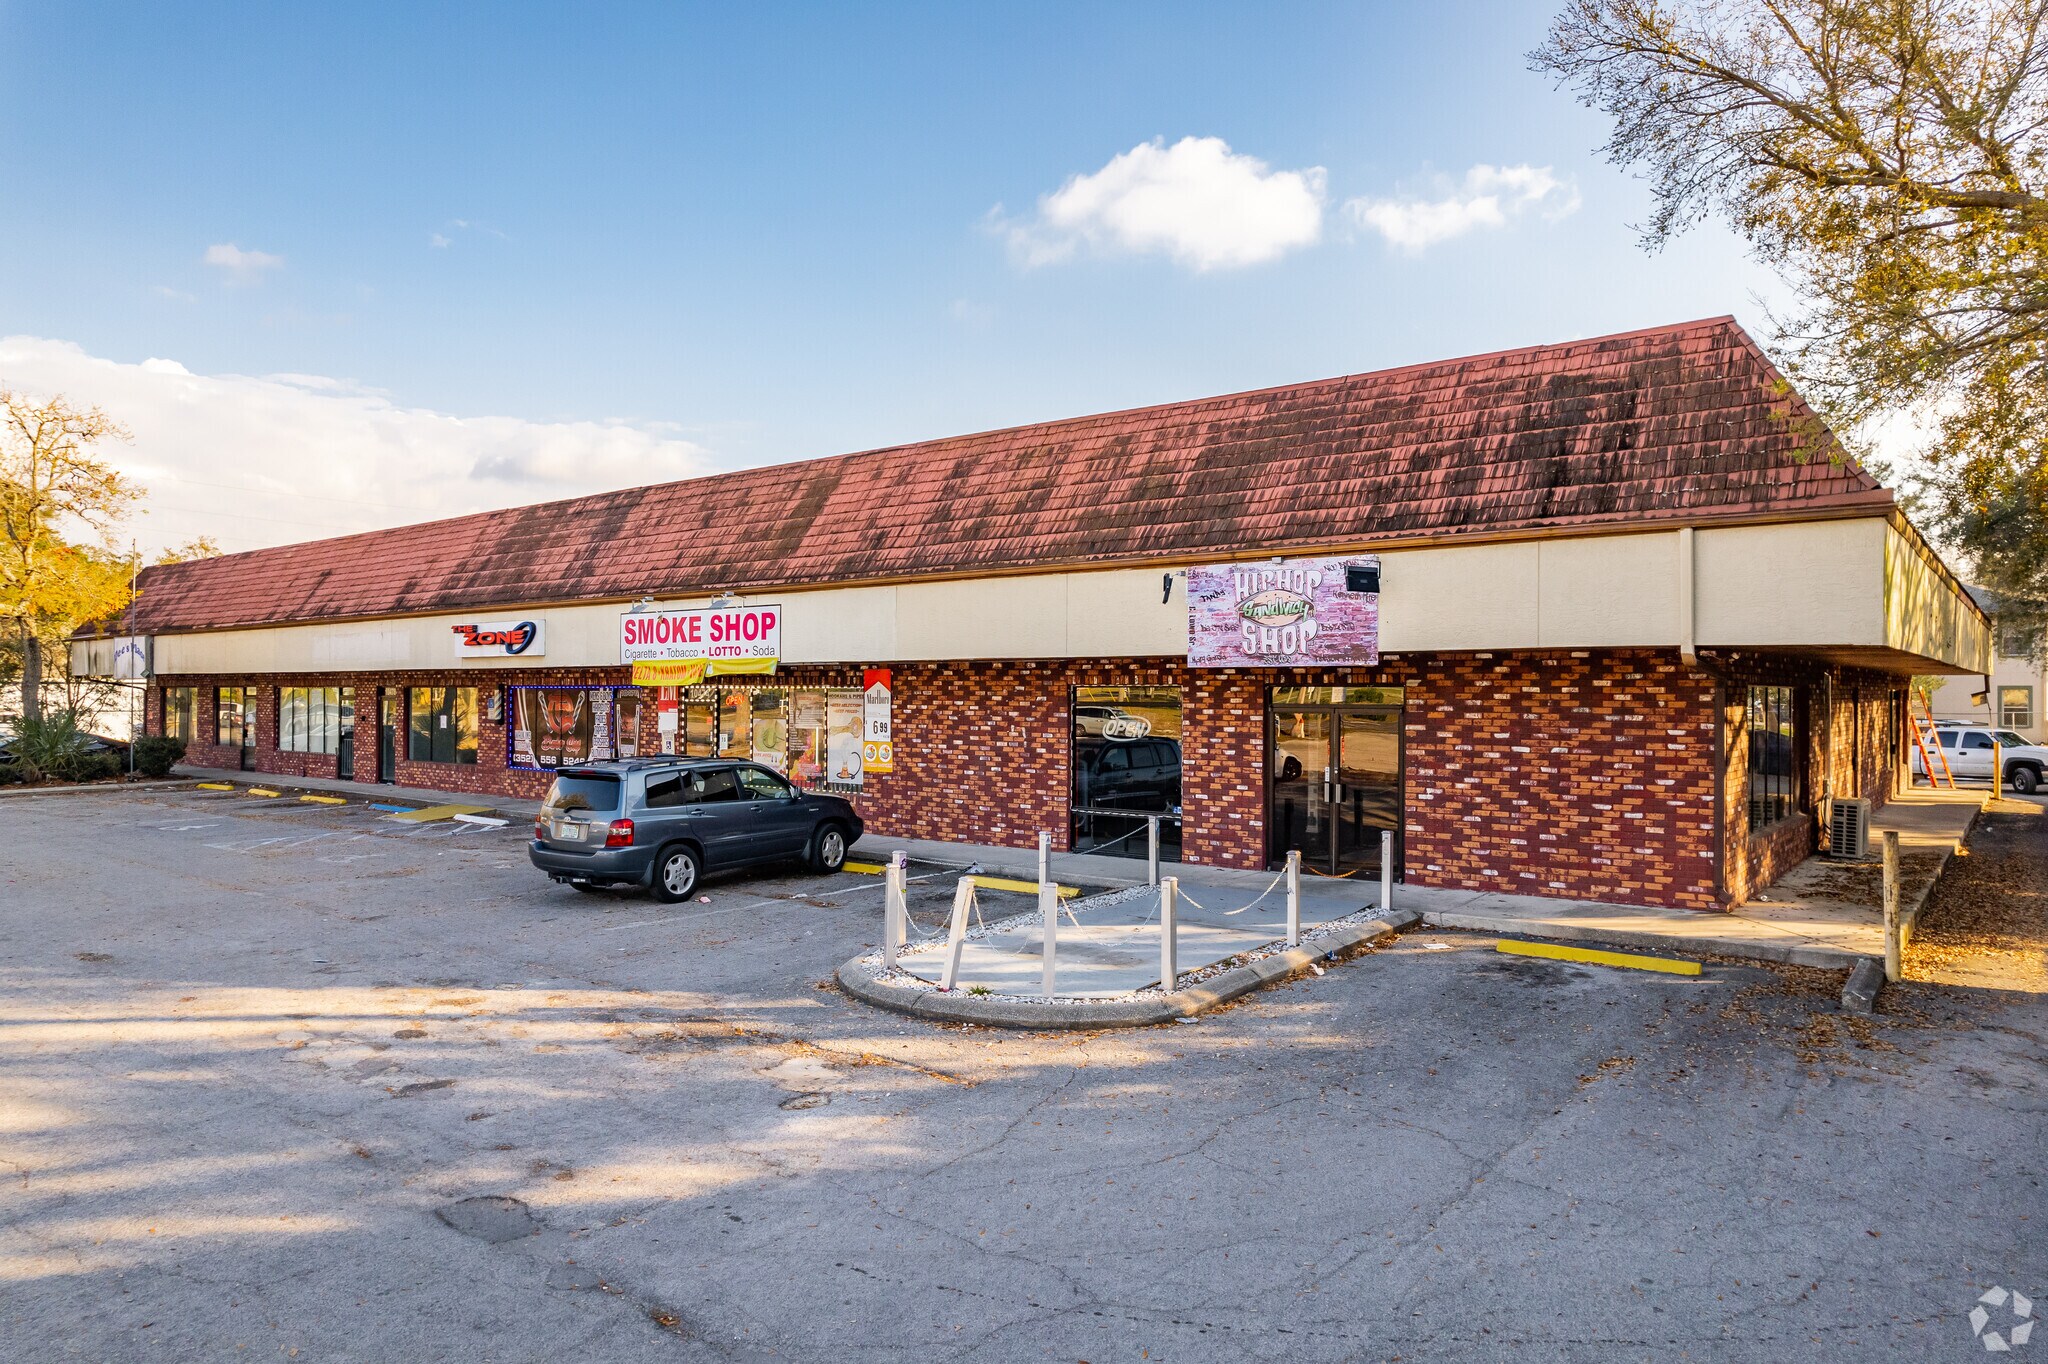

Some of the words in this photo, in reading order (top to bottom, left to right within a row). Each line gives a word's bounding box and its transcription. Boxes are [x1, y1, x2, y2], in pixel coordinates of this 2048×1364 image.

[451, 625, 475, 634] THE
[624, 616, 701, 645] SMOKE
[709, 612, 776, 643] SHOP
[1241, 617, 1318, 655] SHOP
[463, 629, 526, 646] ZONE
[624, 648, 657, 661] Cigarette
[667, 646, 699, 658] Tobacco
[708, 646, 741, 657] LOTTO
[752, 645, 775, 656] Soda
[660, 664, 687, 680] KRATOM
[726, 694, 744, 706] OPEN
[867, 690, 889, 704] Marlboro
[1105, 719, 1146, 738] OPEN
[513, 754, 533, 763] (352)
[540, 755, 556, 764] 556
